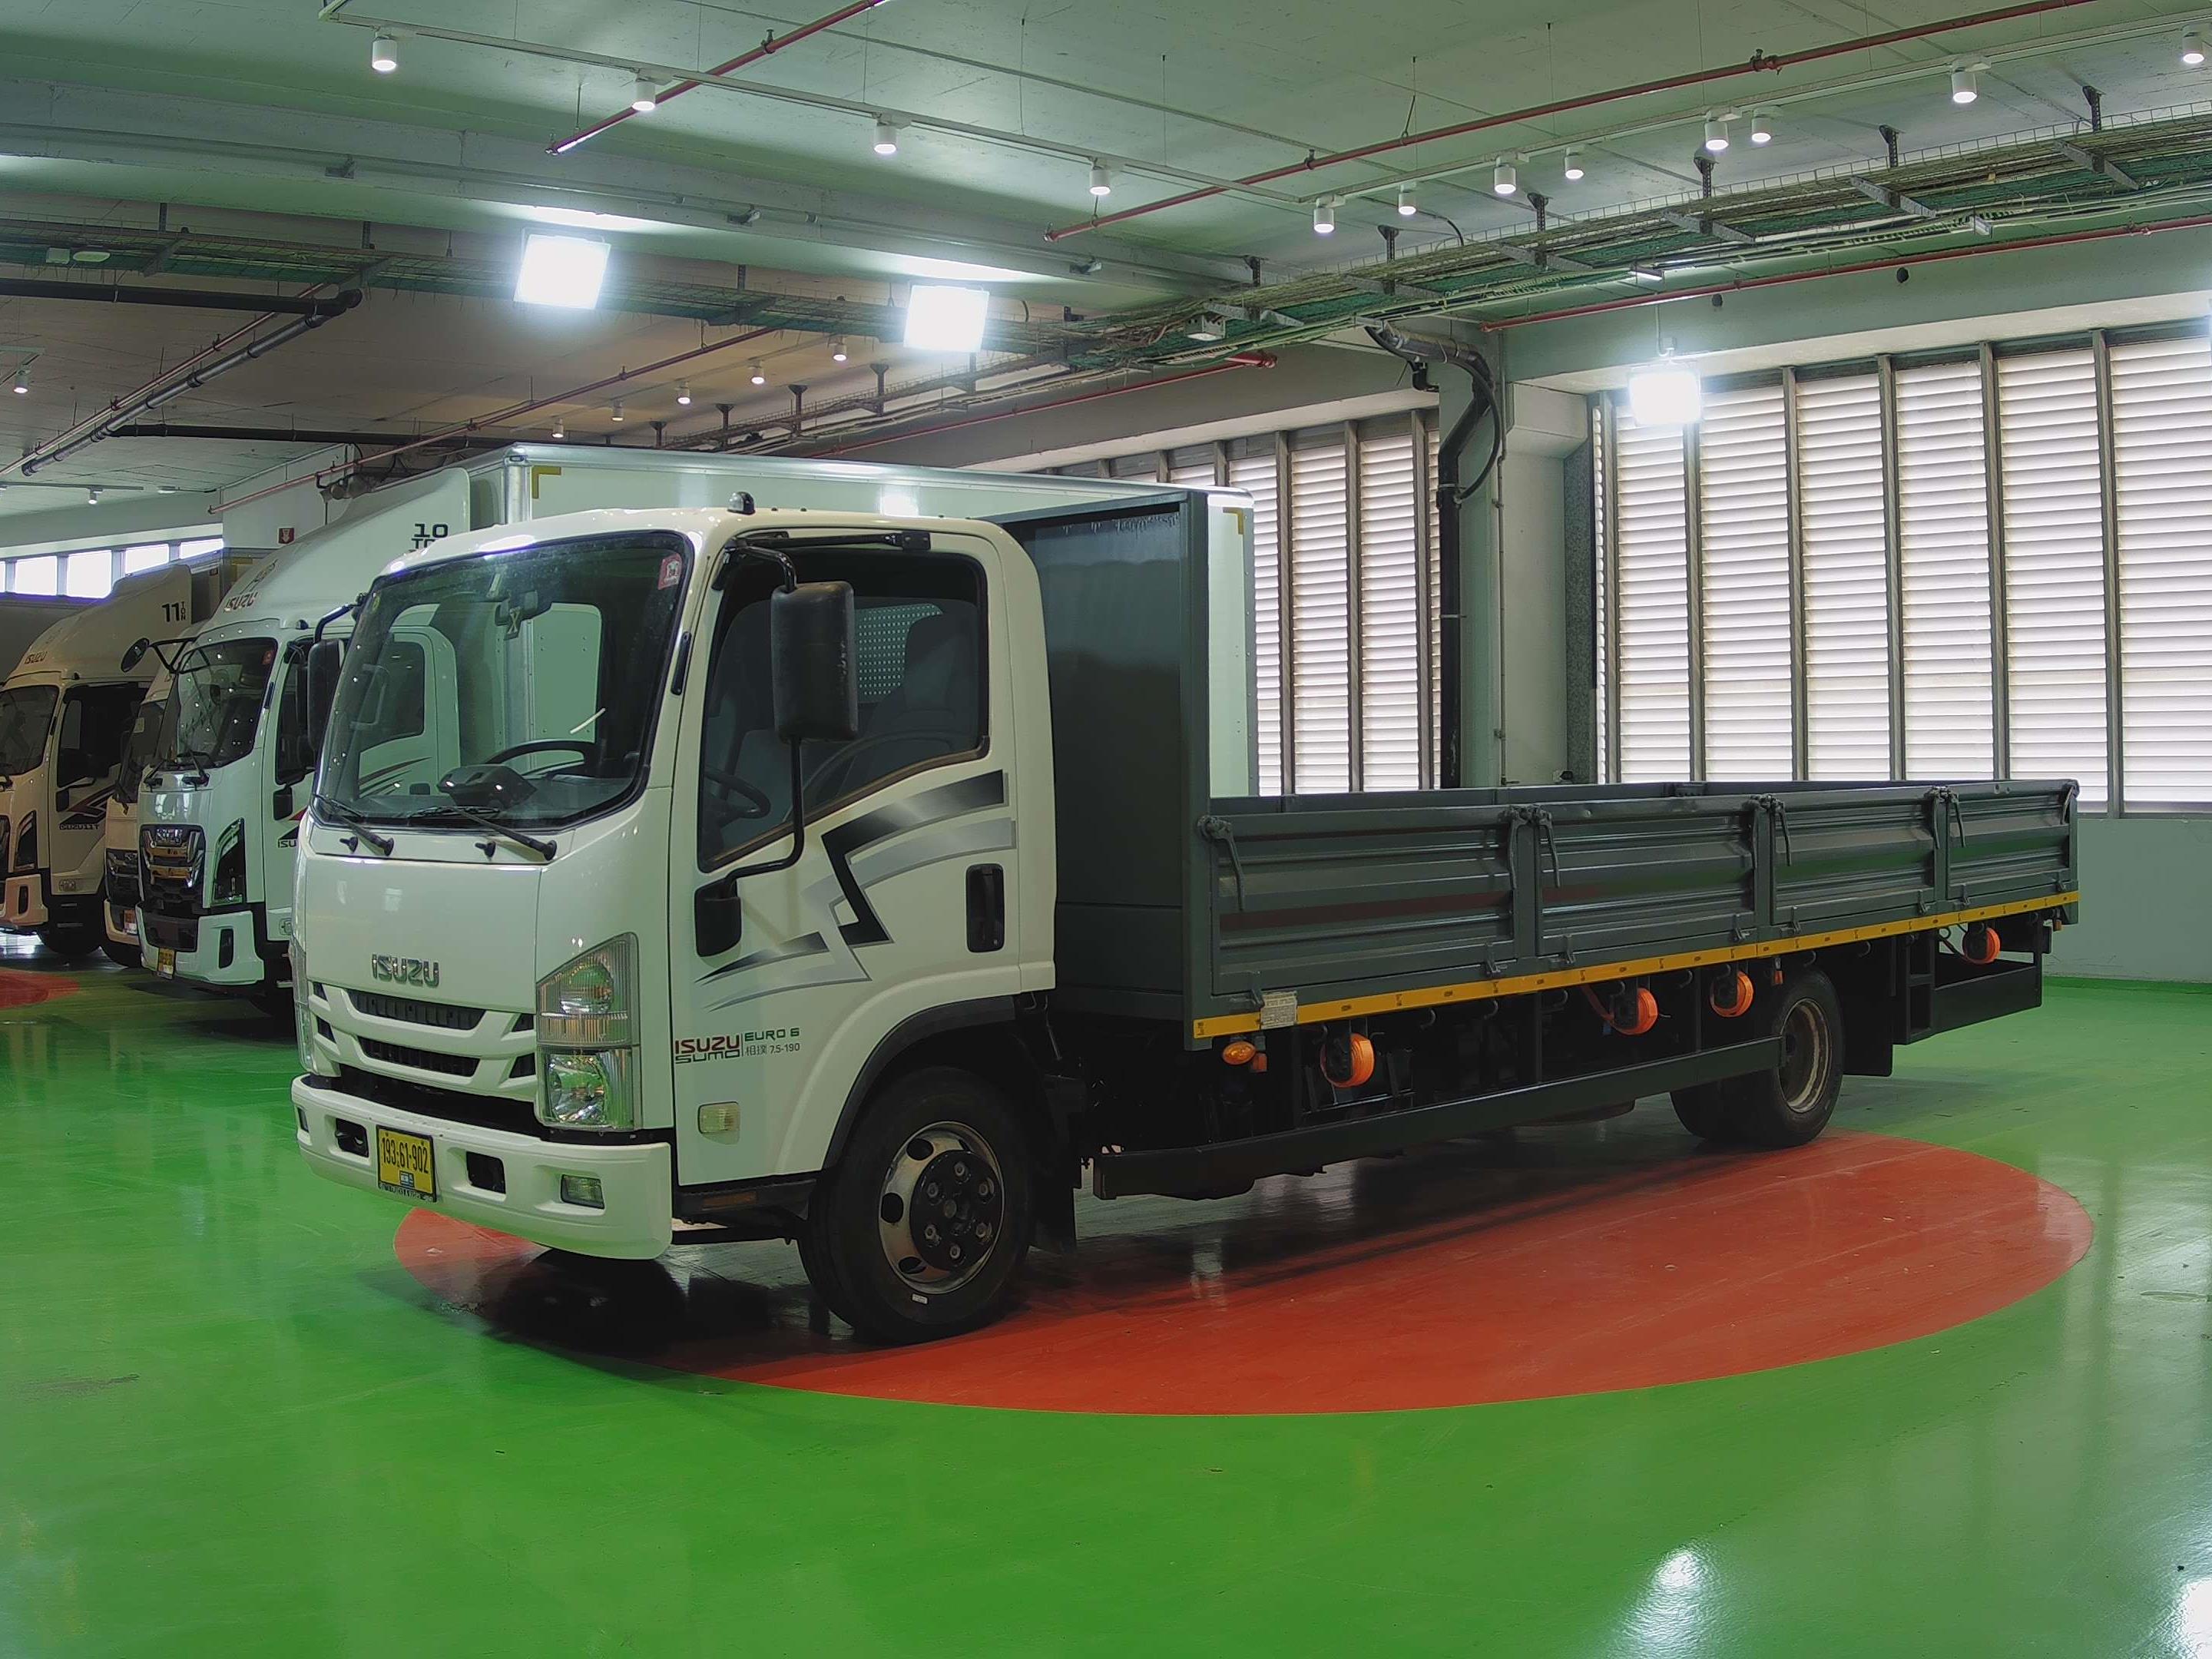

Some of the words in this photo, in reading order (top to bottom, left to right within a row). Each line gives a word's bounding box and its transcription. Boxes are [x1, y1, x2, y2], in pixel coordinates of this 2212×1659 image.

[414, 523, 449, 538] 10
[161, 602, 180, 622] 11
[371, 954, 439, 988] ISUZU
[744, 1029, 786, 1042] EURO
[790, 1027, 800, 1038] 6
[675, 1034, 740, 1055] ISUZU
[769, 1041, 801, 1055] 7.5-190
[675, 1049, 740, 1065] SUMO
